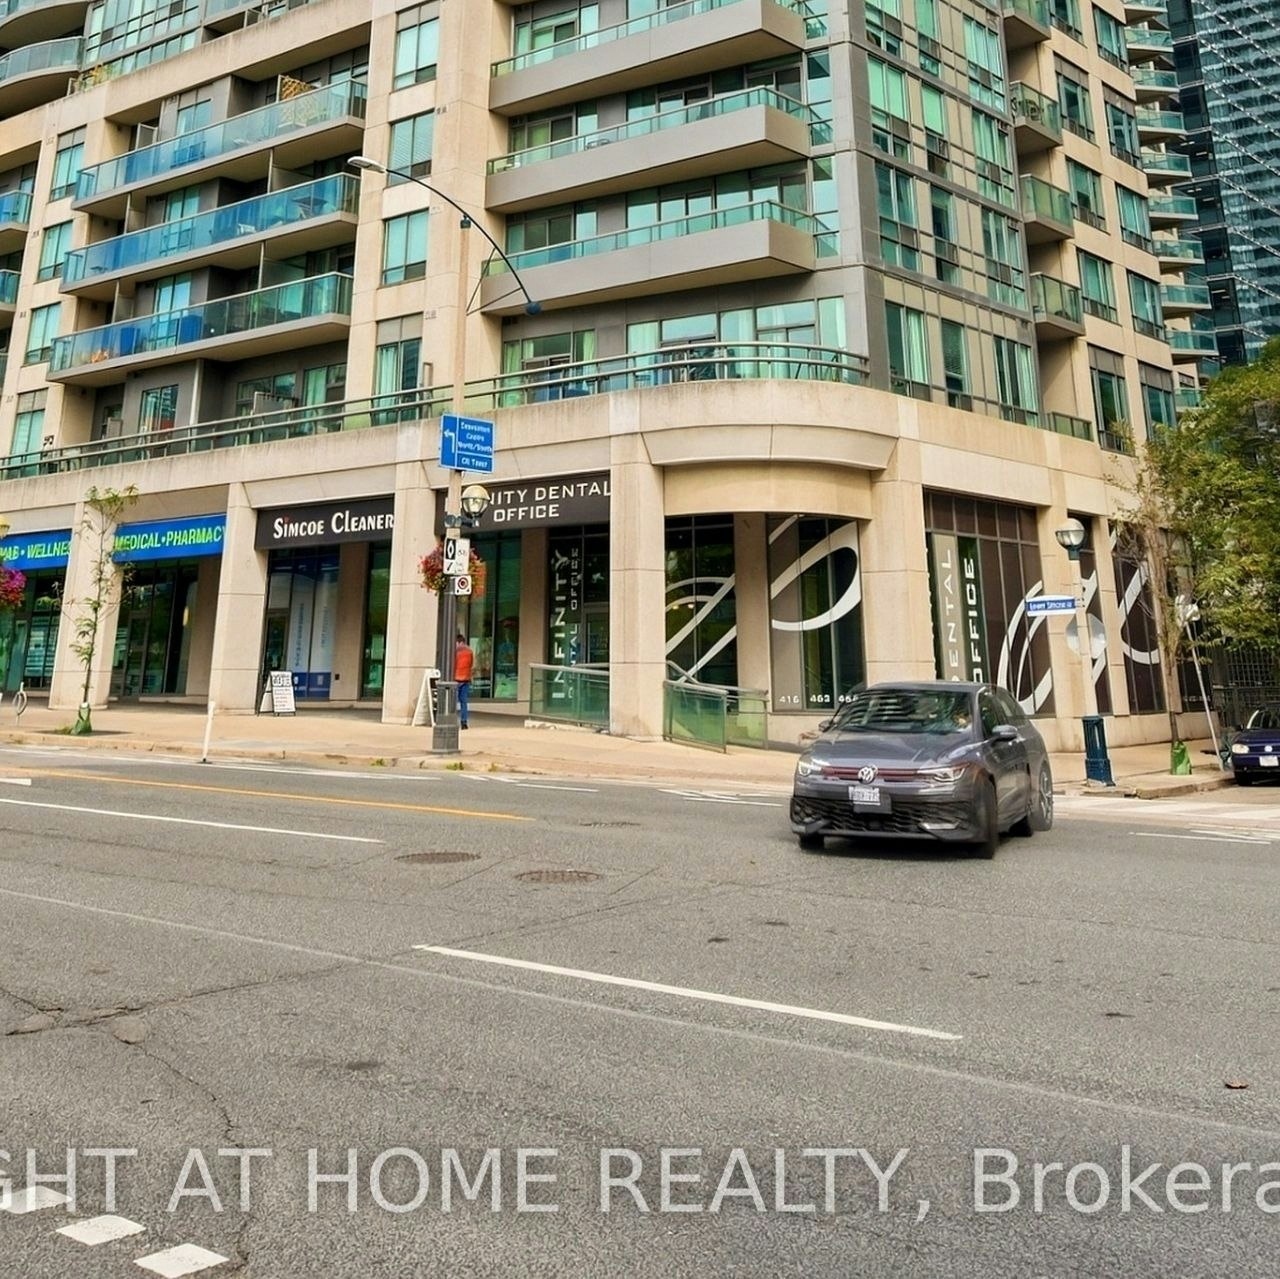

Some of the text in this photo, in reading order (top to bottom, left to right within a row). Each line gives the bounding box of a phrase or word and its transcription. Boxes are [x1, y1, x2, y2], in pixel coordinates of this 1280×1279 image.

[535, 480, 611, 502] DENTAL
[493, 503, 560, 523] OFFICE
[114, 532, 162, 551] MEDICAL
[779, 695, 800, 704] 416
